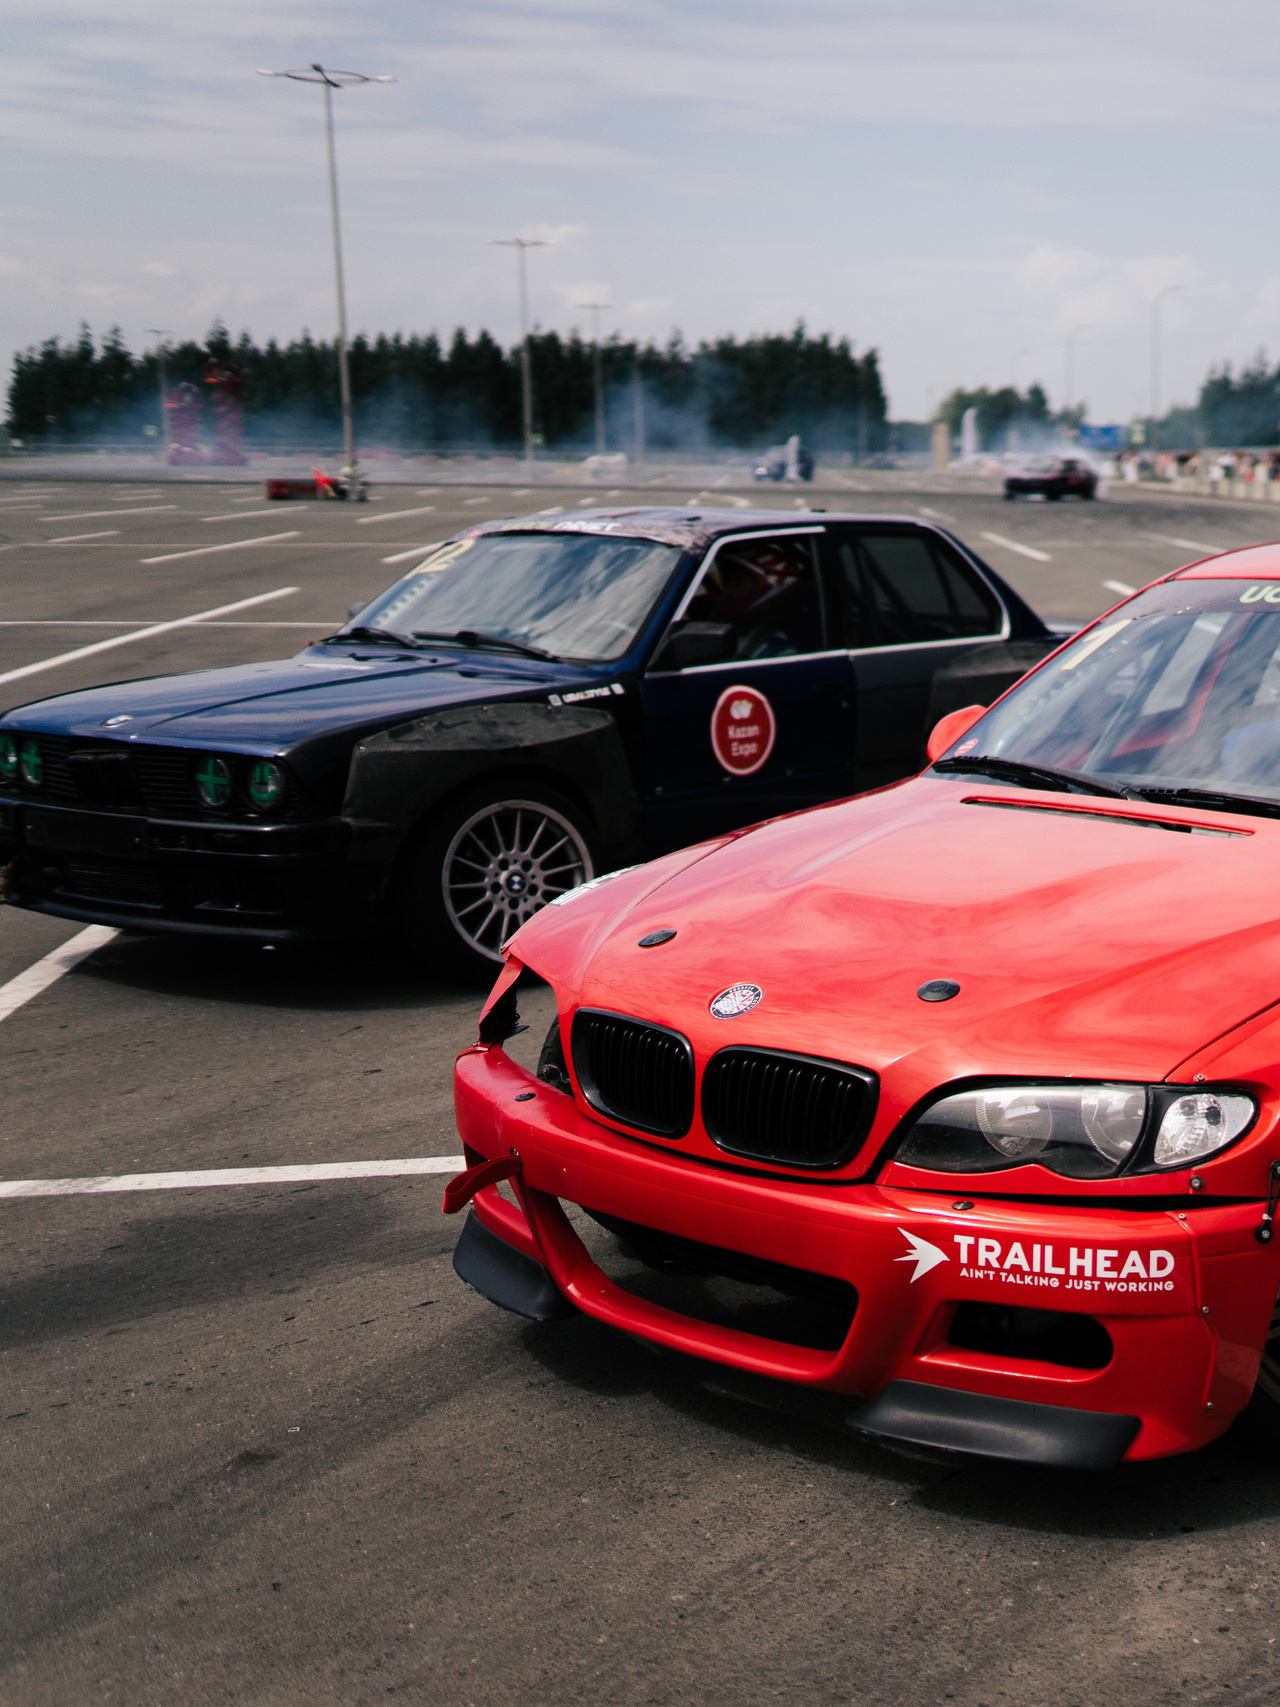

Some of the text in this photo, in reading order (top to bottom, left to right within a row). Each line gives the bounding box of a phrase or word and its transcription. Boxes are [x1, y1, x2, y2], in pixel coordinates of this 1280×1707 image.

[1060, 619, 1133, 671] 1
[728, 725, 760, 739] Kazan
[731, 742, 758, 758] Expo
[954, 1234, 1175, 1279] TRAILHEAD
[960, 1267, 1175, 1292] AIN'T TALKING JUST WORKING
